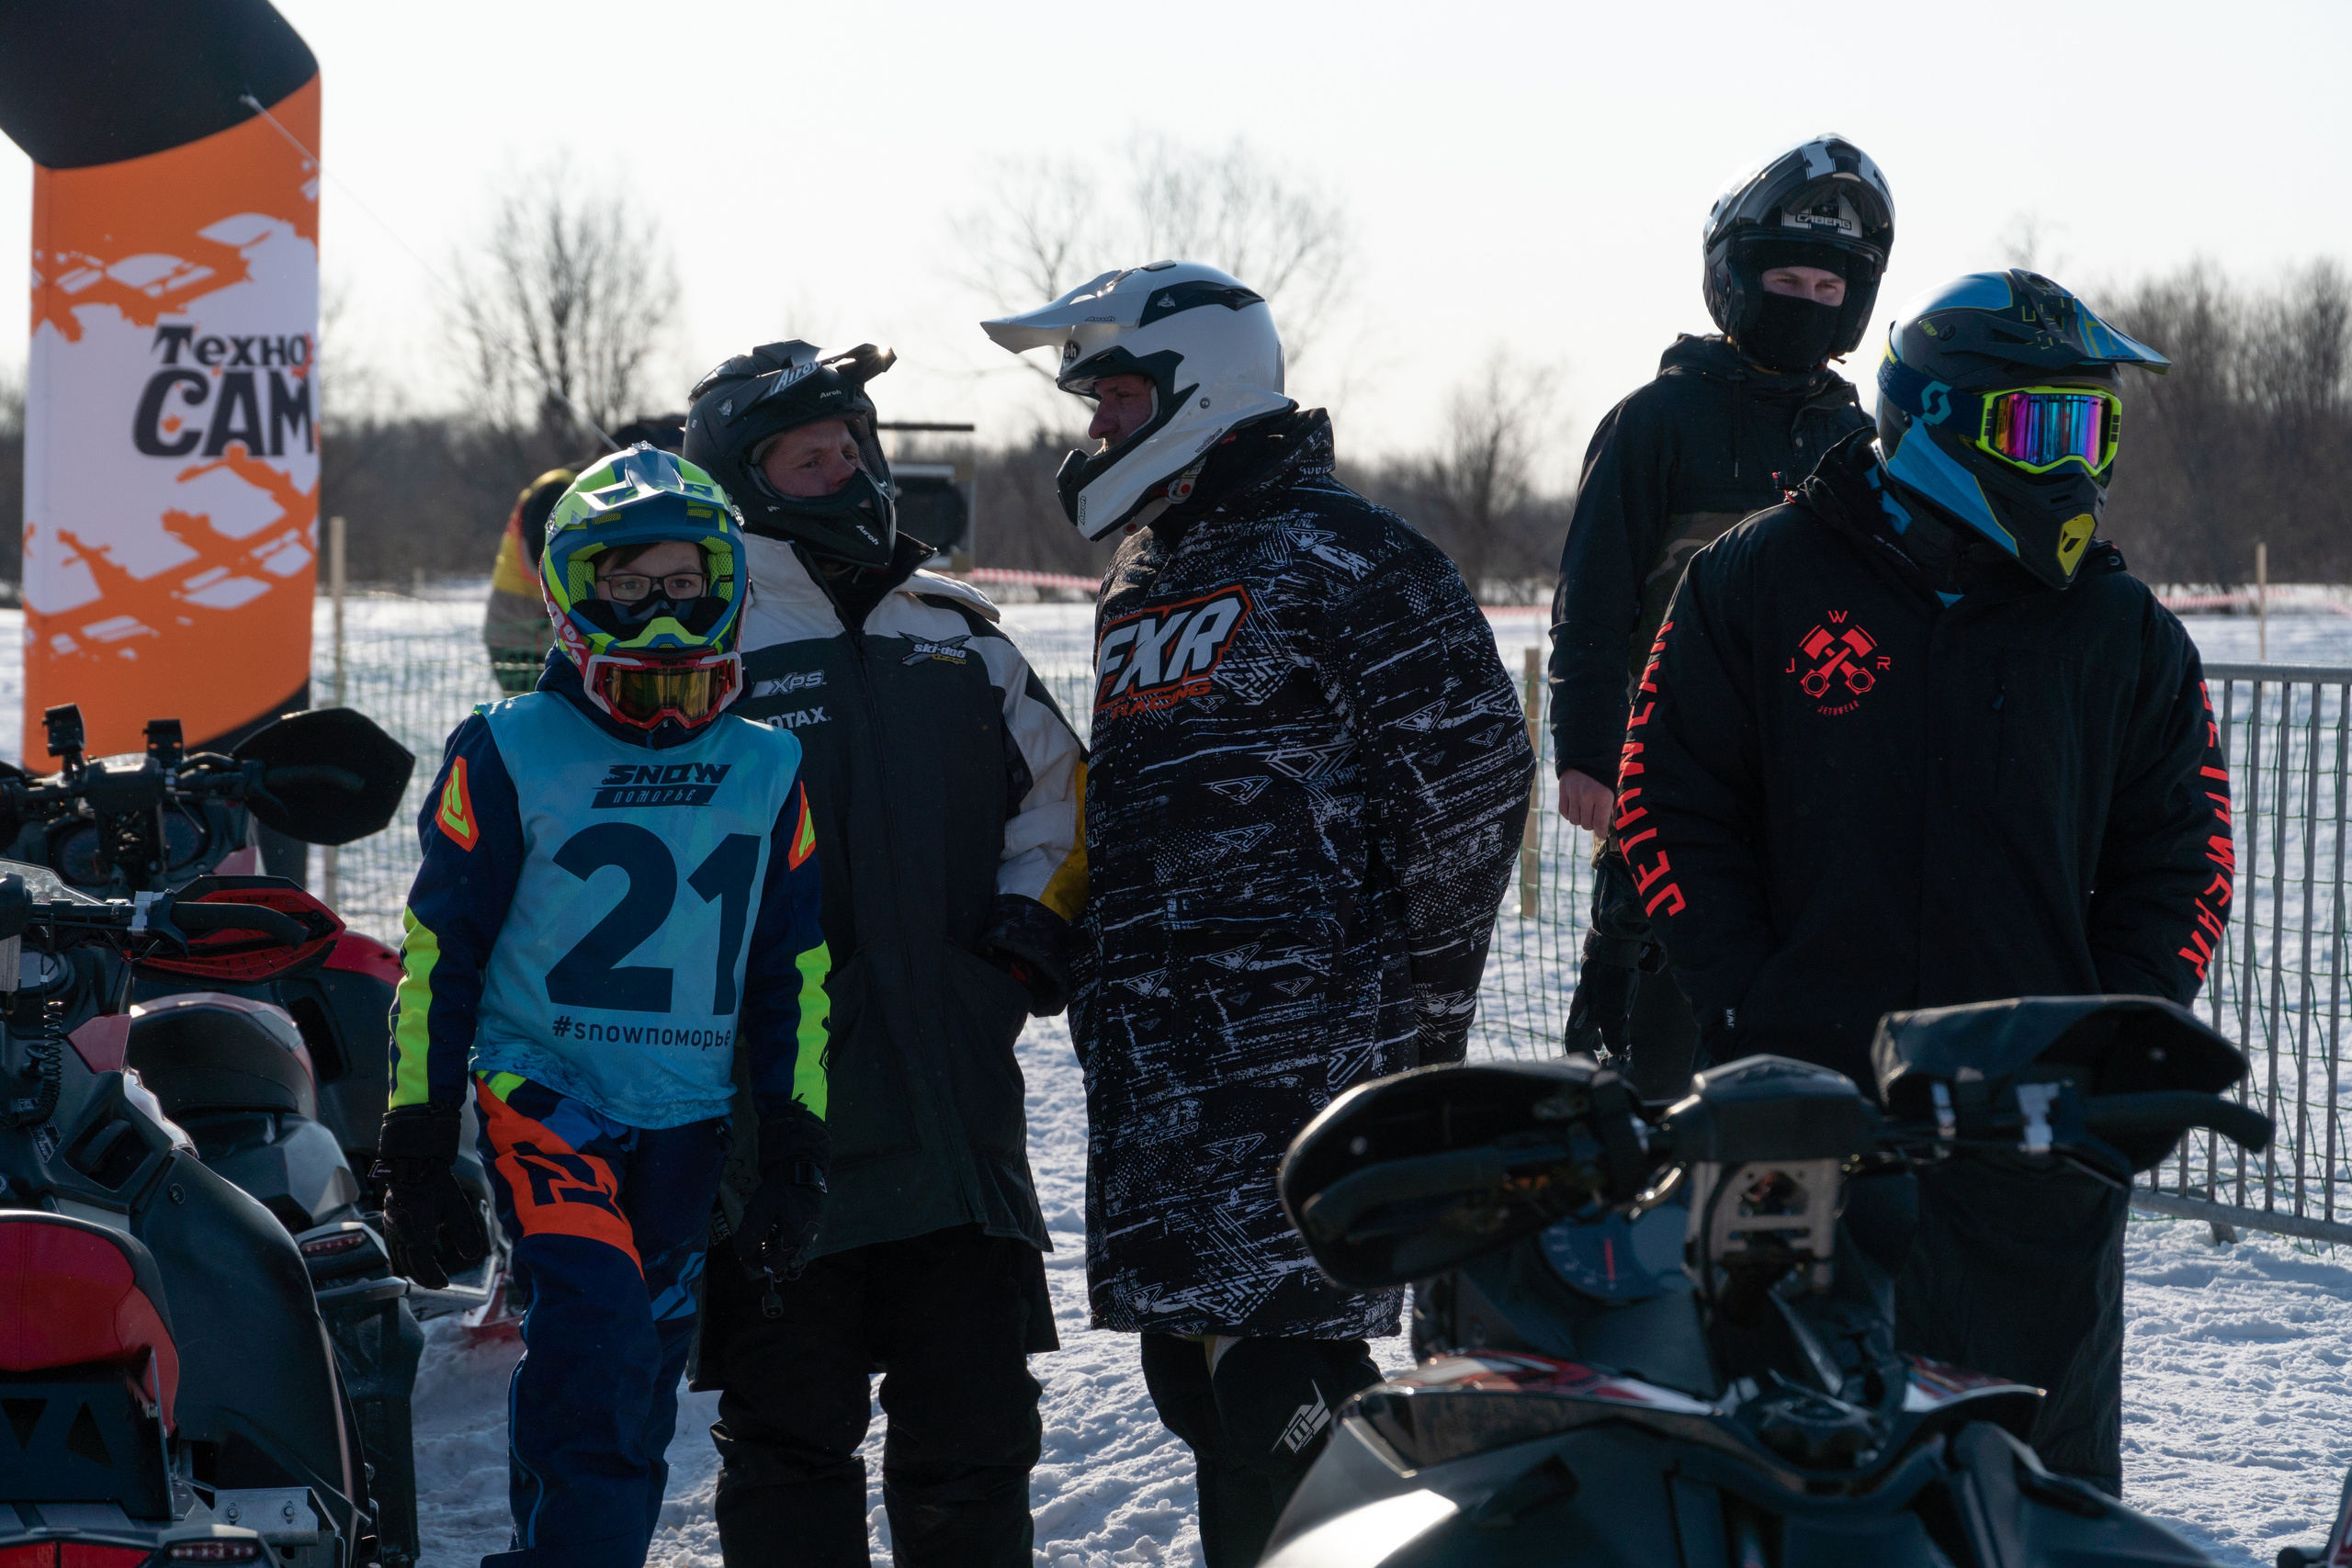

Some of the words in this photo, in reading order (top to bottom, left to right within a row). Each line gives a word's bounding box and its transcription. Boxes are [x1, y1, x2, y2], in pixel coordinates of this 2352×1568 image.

[1797, 215, 1850, 229] CABERG
[152, 325, 307, 366] Техно
[774, 361, 821, 393] Airoh
[820, 389, 842, 399] Airoh
[134, 369, 313, 457] САМ
[855, 524, 879, 547] Airoh
[913, 643, 967, 659] ski-doo
[1093, 597, 1241, 705] FXR
[1827, 610, 1849, 624] W
[1877, 656, 1891, 671] R
[772, 670, 825, 694] XPS
[1111, 682, 1212, 720] RACING
[1817, 700, 1860, 716] JETHWEAR
[601, 762, 732, 785] SNOW
[545, 822, 762, 1016] 21
